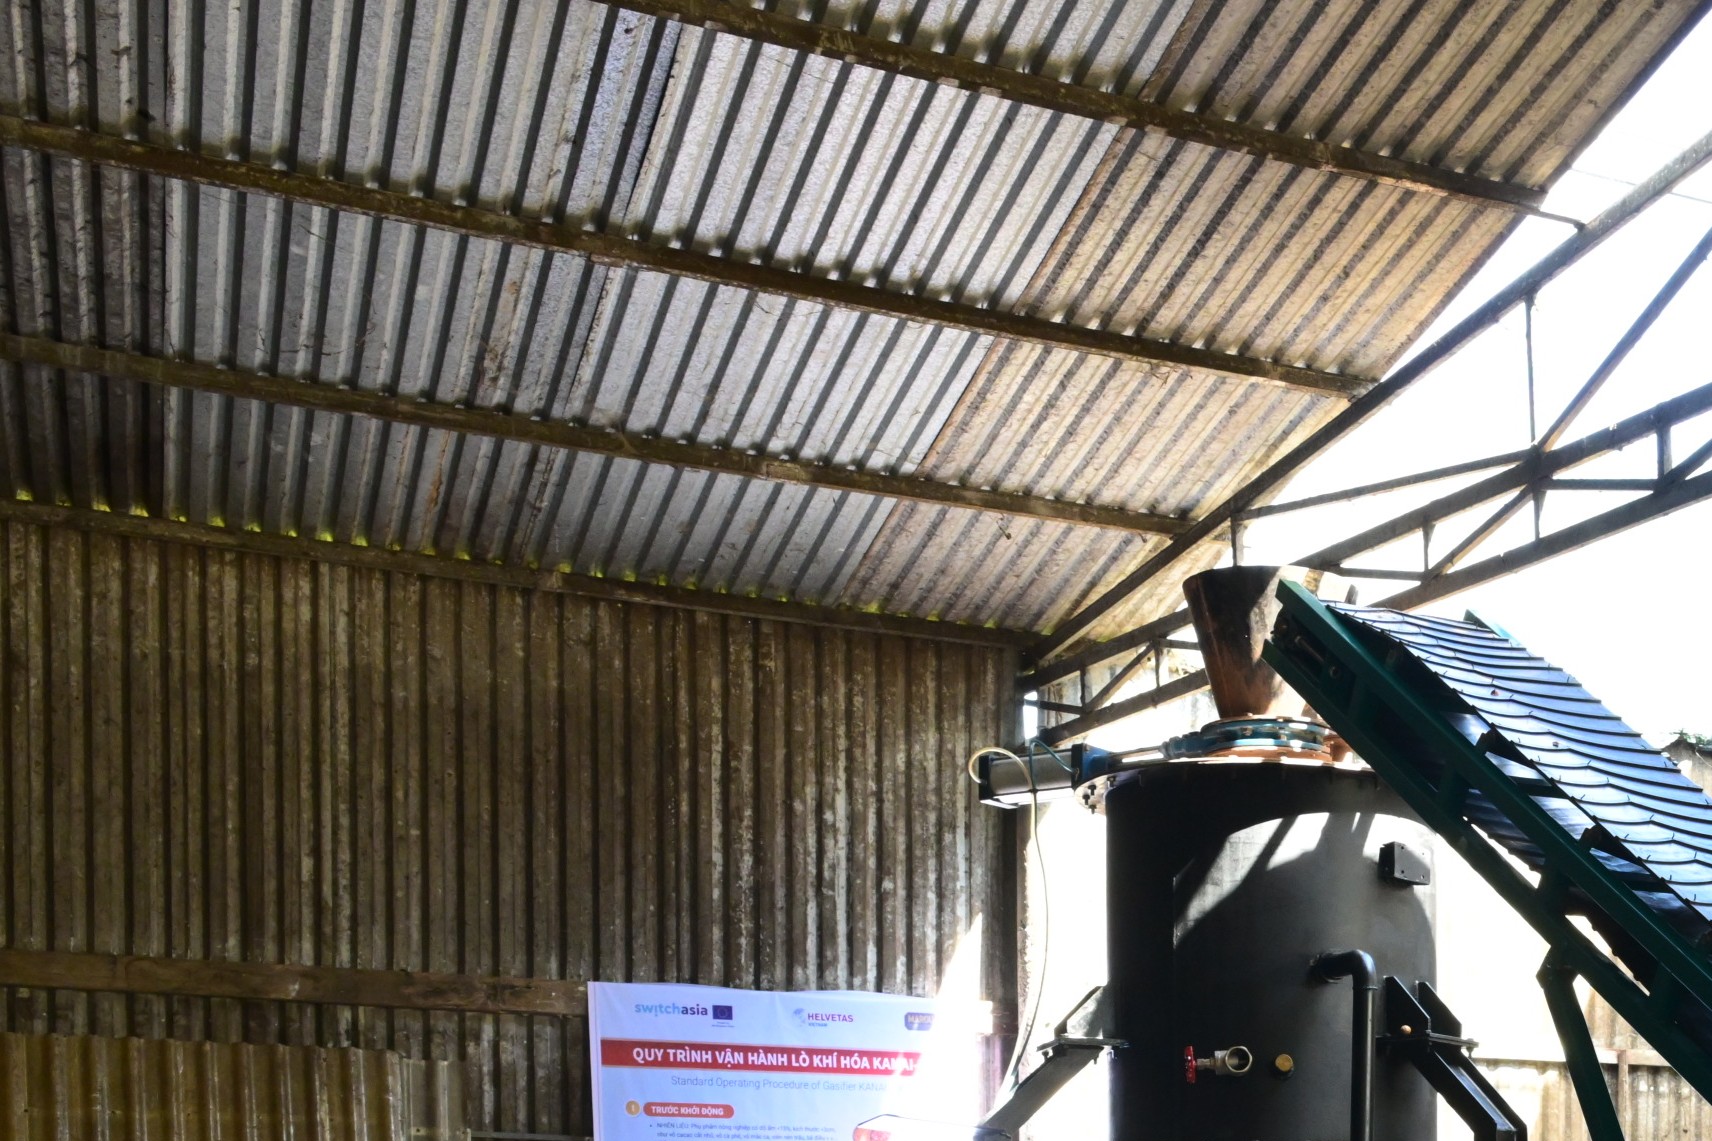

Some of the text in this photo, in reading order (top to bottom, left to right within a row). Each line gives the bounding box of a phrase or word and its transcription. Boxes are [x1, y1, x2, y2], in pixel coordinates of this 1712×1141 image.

[635, 1001, 708, 1017] switchasia
[808, 1013, 854, 1023] HELVETAS
[633, 1047, 663, 1063] QUY
[667, 1046, 712, 1063] TRÌNH
[716, 1049, 744, 1068] VẬN
[748, 1050, 787, 1066] HÀNH
[792, 1051, 809, 1067] LÒ
[813, 1052, 837, 1068] KHÍ
[841, 1053, 870, 1069] HÓA
[672, 1076, 713, 1086] Standard
[716, 1077, 760, 1089] Operating
[763, 1080, 809, 1089] Procedure
[811, 1081, 820, 1090] of
[823, 1082, 856, 1091] Gasifier
[652, 1105, 678, 1114] TRƯỚC
[681, 1106, 700, 1114] KHỞI
[702, 1107, 723, 1116] ĐỘNG
